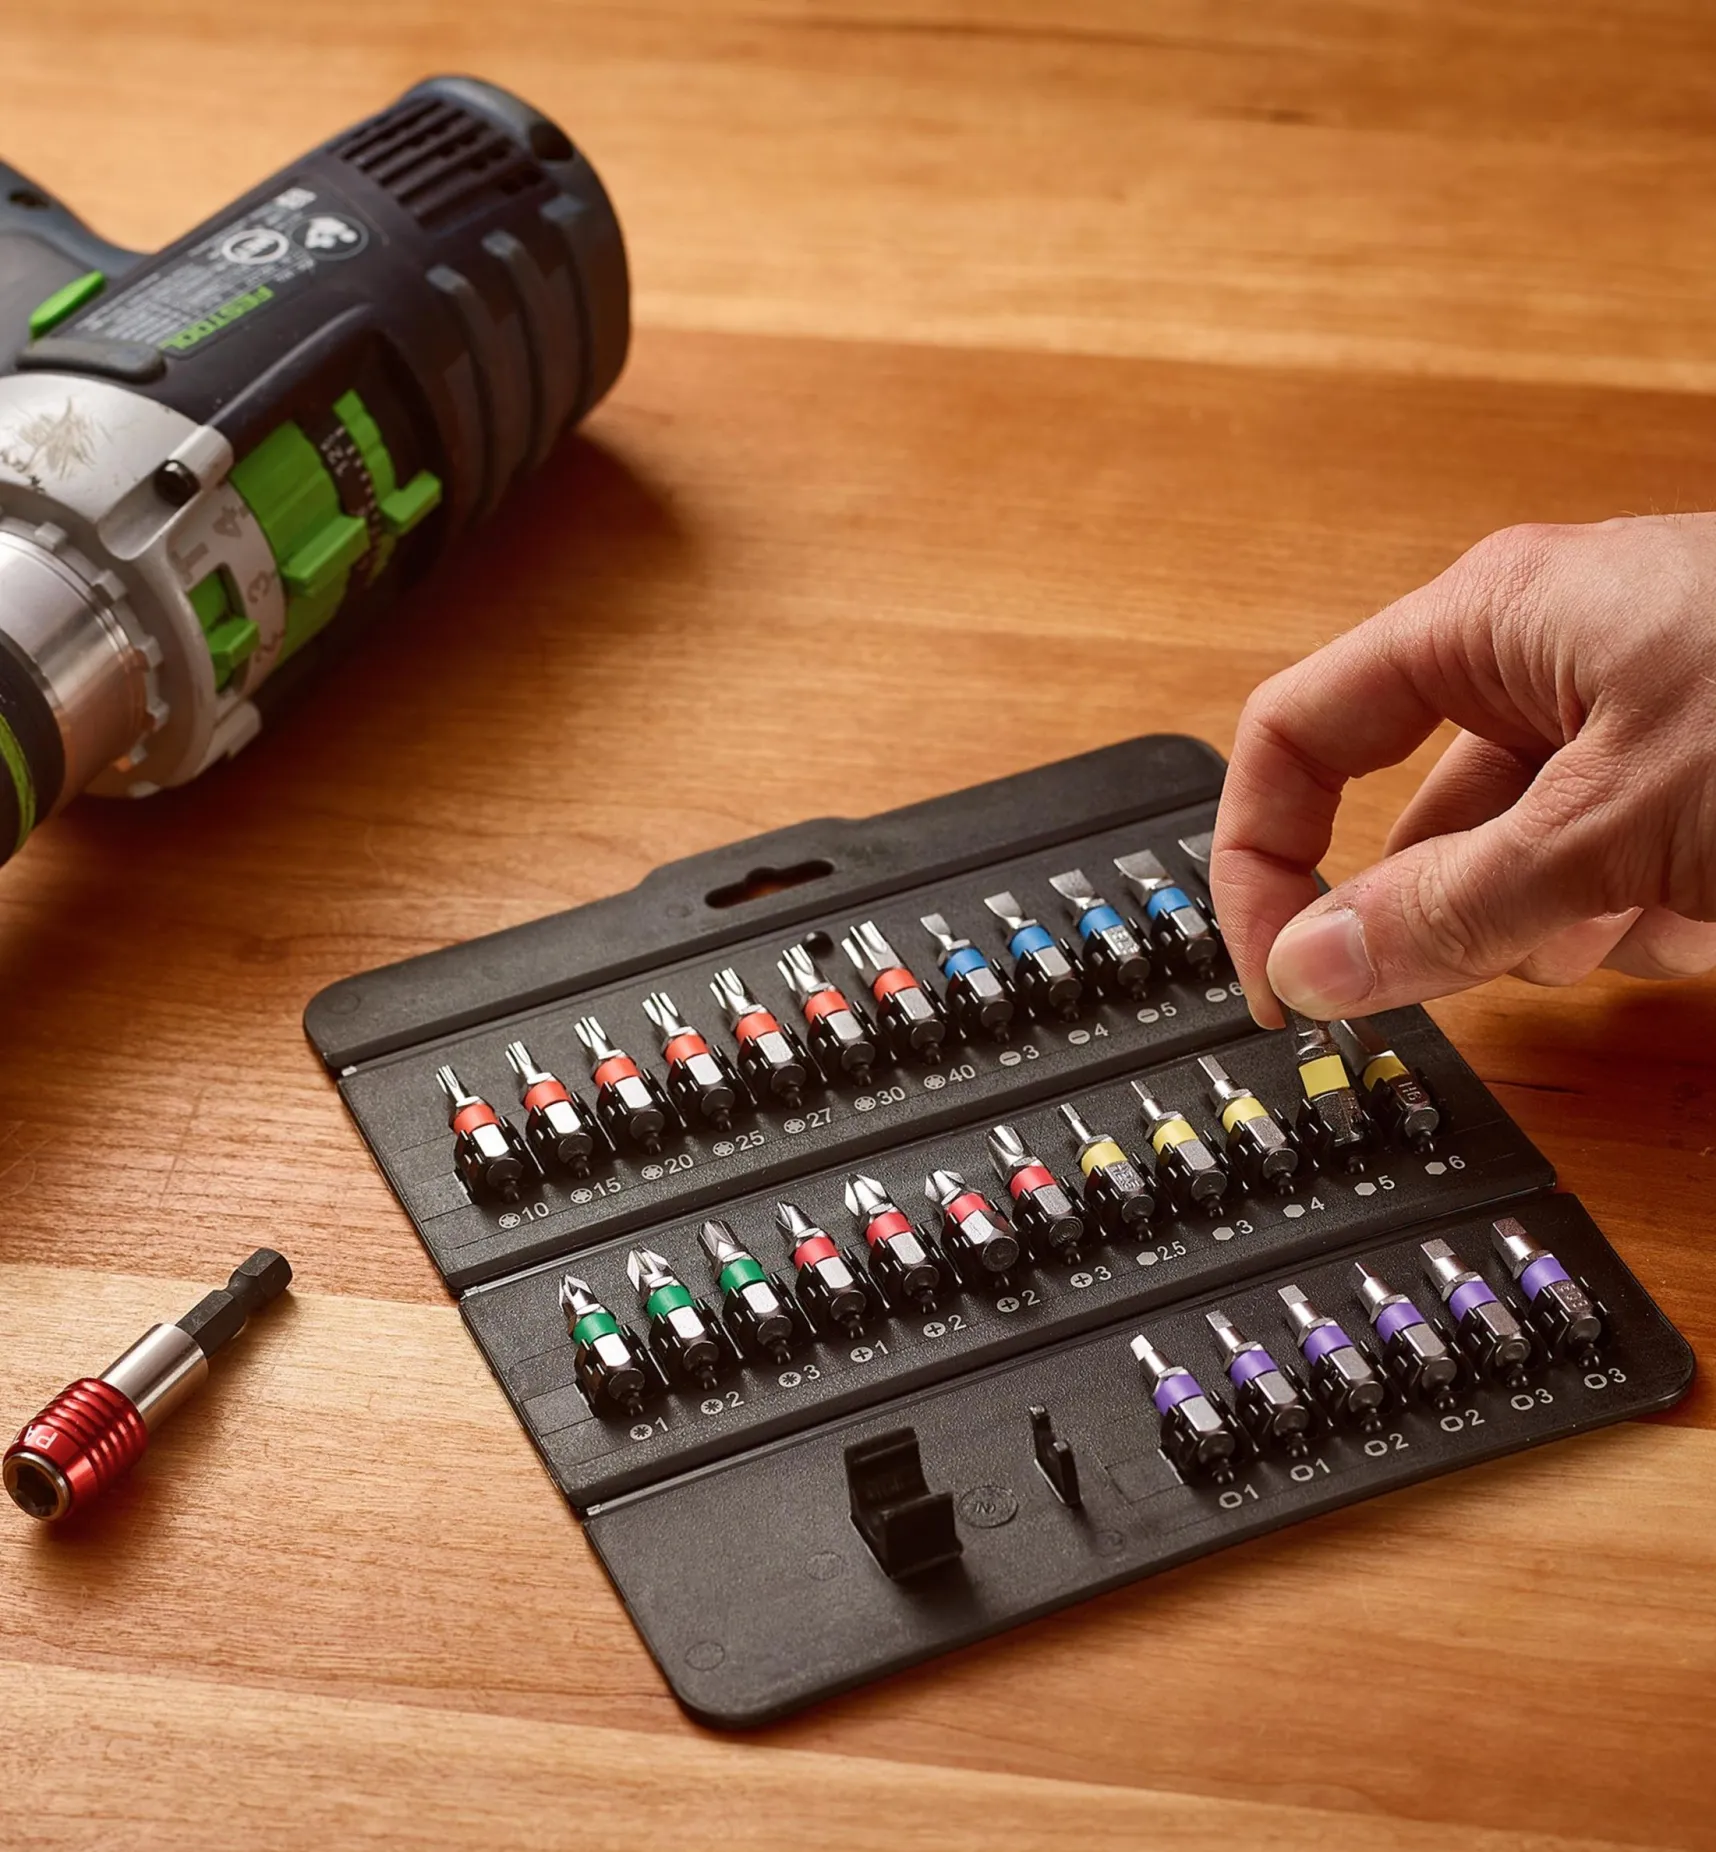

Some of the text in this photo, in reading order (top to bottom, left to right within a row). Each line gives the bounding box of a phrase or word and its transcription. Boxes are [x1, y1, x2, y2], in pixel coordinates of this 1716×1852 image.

[159, 285, 274, 349] FESTOOL
[1229, 982, 1243, 996] 6
[1161, 1003, 1177, 1017] 5
[1095, 1024, 1109, 1037] 4
[1024, 1046, 1040, 1060] 3
[950, 1065, 976, 1082] 40
[877, 1087, 906, 1106] 30
[807, 1108, 832, 1128] 27
[736, 1131, 765, 1151] 25
[665, 1155, 694, 1175] 20
[1449, 1156, 1466, 1170] 6
[594, 1178, 622, 1197] 15
[1379, 1176, 1395, 1190] 5
[1311, 1197, 1325, 1211] 4
[523, 1203, 550, 1221] 10
[1237, 1220, 1254, 1235] 3
[1158, 1241, 1187, 1261] 2.5
[1095, 1267, 1112, 1281] 3
[1022, 1290, 1041, 1306] 2
[949, 1315, 967, 1331] 2
[876, 1341, 889, 1355] 1
[804, 1365, 821, 1380] 3
[1609, 1368, 1627, 1384] 3
[727, 1392, 745, 1408] 2
[1536, 1389, 1554, 1404] 3
[656, 1418, 669, 1432] 1
[1466, 1410, 1485, 1426] 2
[1390, 1434, 1409, 1450] 2
[1317, 1459, 1331, 1474] 1
[1245, 1485, 1259, 1500] 1
